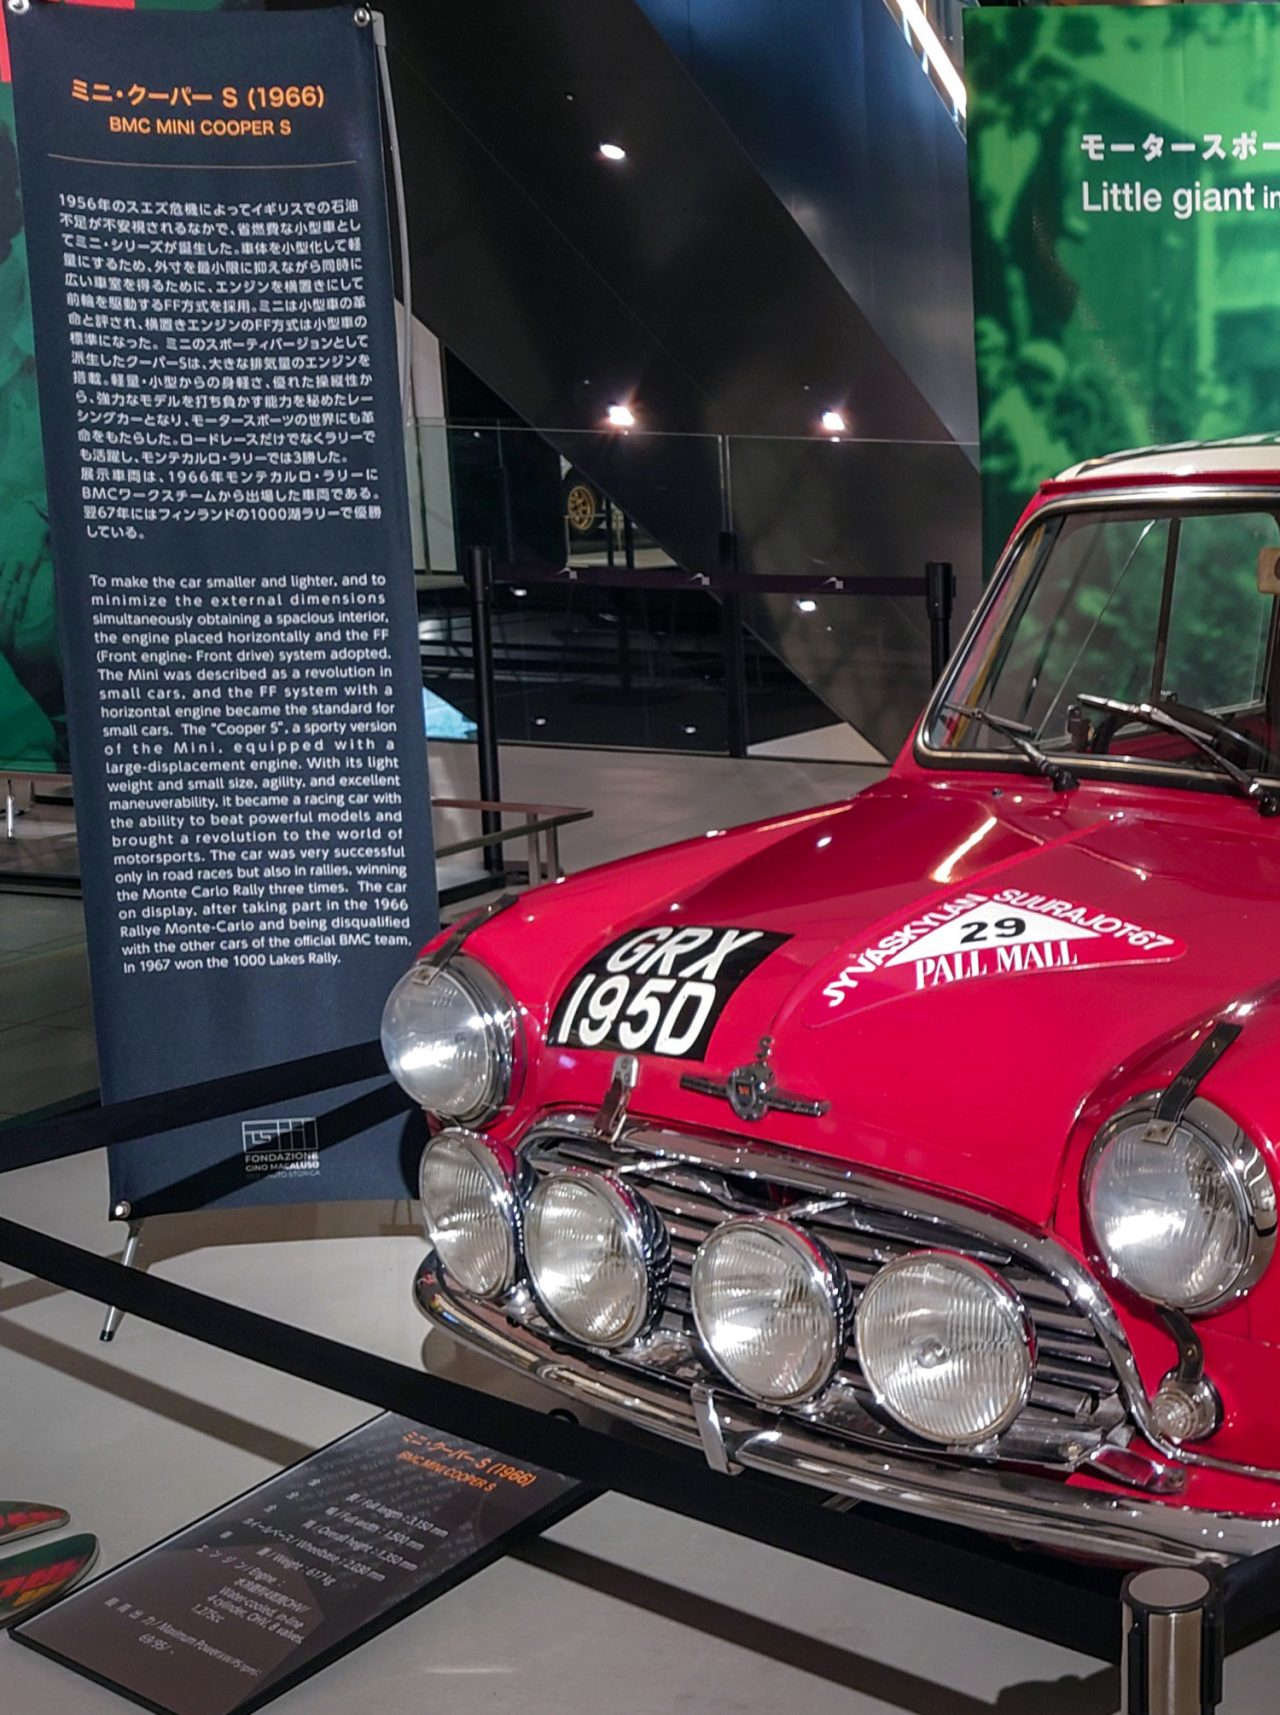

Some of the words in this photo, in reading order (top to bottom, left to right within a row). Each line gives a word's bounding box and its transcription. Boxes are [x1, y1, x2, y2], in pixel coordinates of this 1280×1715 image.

[71, 78, 213, 107] ミニ・クーパー
[222, 87, 238, 108] S
[248, 84, 325, 110] (1966)
[109, 116, 151, 134] BMC
[156, 118, 195, 136] MINI
[200, 119, 276, 136] COOPER
[280, 120, 292, 136] S
[1082, 181, 1162, 213] Little
[1173, 182, 1255, 219] giant
[77, 410, 374, 426] シングカーとなり、モータースポーツの世界にも革
[77, 429, 375, 445] 命をもたらした。ロードレースだけでなくラリーで
[86, 525, 144, 539] している。
[89, 574, 106, 587] To
[111, 575, 148, 588] make
[152, 575, 175, 588] the
[179, 578, 201, 588] car
[206, 575, 256, 588] smaller
[260, 575, 286, 587] and
[341, 573, 367, 586] and
[371, 574, 386, 585] to
[91, 593, 166, 607] minimize
[175, 594, 202, 607] the
[210, 593, 282, 606] external
[289, 592, 385, 605] dimensions
[92, 612, 193, 628] simultaneously
[197, 612, 260, 628] obtaining
[264, 614, 272, 624] a
[276, 611, 334, 626] spacious
[94, 631, 117, 643] the
[122, 631, 169, 647] engine
[174, 631, 223, 646] placed
[227, 629, 310, 645] horizontally
[315, 629, 341, 641] and
[345, 628, 368, 641] the
[373, 628, 388, 640] FF
[96, 649, 137, 662] (Front
[141, 650, 192, 665] engine-
[196, 649, 232, 662] Front
[236, 649, 274, 662] drive)
[279, 648, 326, 663] system
[330, 646, 391, 662] adopted.
[97, 668, 123, 681] The
[128, 668, 158, 680] Mini
[163, 670, 192, 680] was
[196, 667, 266, 680] described
[271, 668, 287, 679] as
[292, 668, 300, 679] a
[305, 665, 375, 678] revolution
[379, 665, 392, 677] in
[99, 687, 141, 699] small
[192, 686, 221, 699] and
[227, 686, 253, 698] the
[259, 685, 276, 697] FF
[284, 685, 337, 699] system
[343, 682, 377, 695] with
[384, 685, 392, 696] a
[101, 705, 170, 718] horizontal
[175, 705, 221, 720] engine
[225, 703, 280, 716] became
[284, 703, 307, 715] the
[311, 701, 372, 715] standard
[376, 700, 395, 714] for
[992, 888, 1175, 951] SUURAJOT-67
[960, 917, 1027, 944] 29
[606, 925, 762, 981] GRX
[914, 941, 989, 990] PALL
[995, 939, 1078, 972] MALL
[557, 974, 717, 1057] 195D
[245, 1152, 319, 1163] FONDAZIONE
[270, 1161, 320, 1171] MACALUSO
[487, 1462, 537, 1486] (1966)
